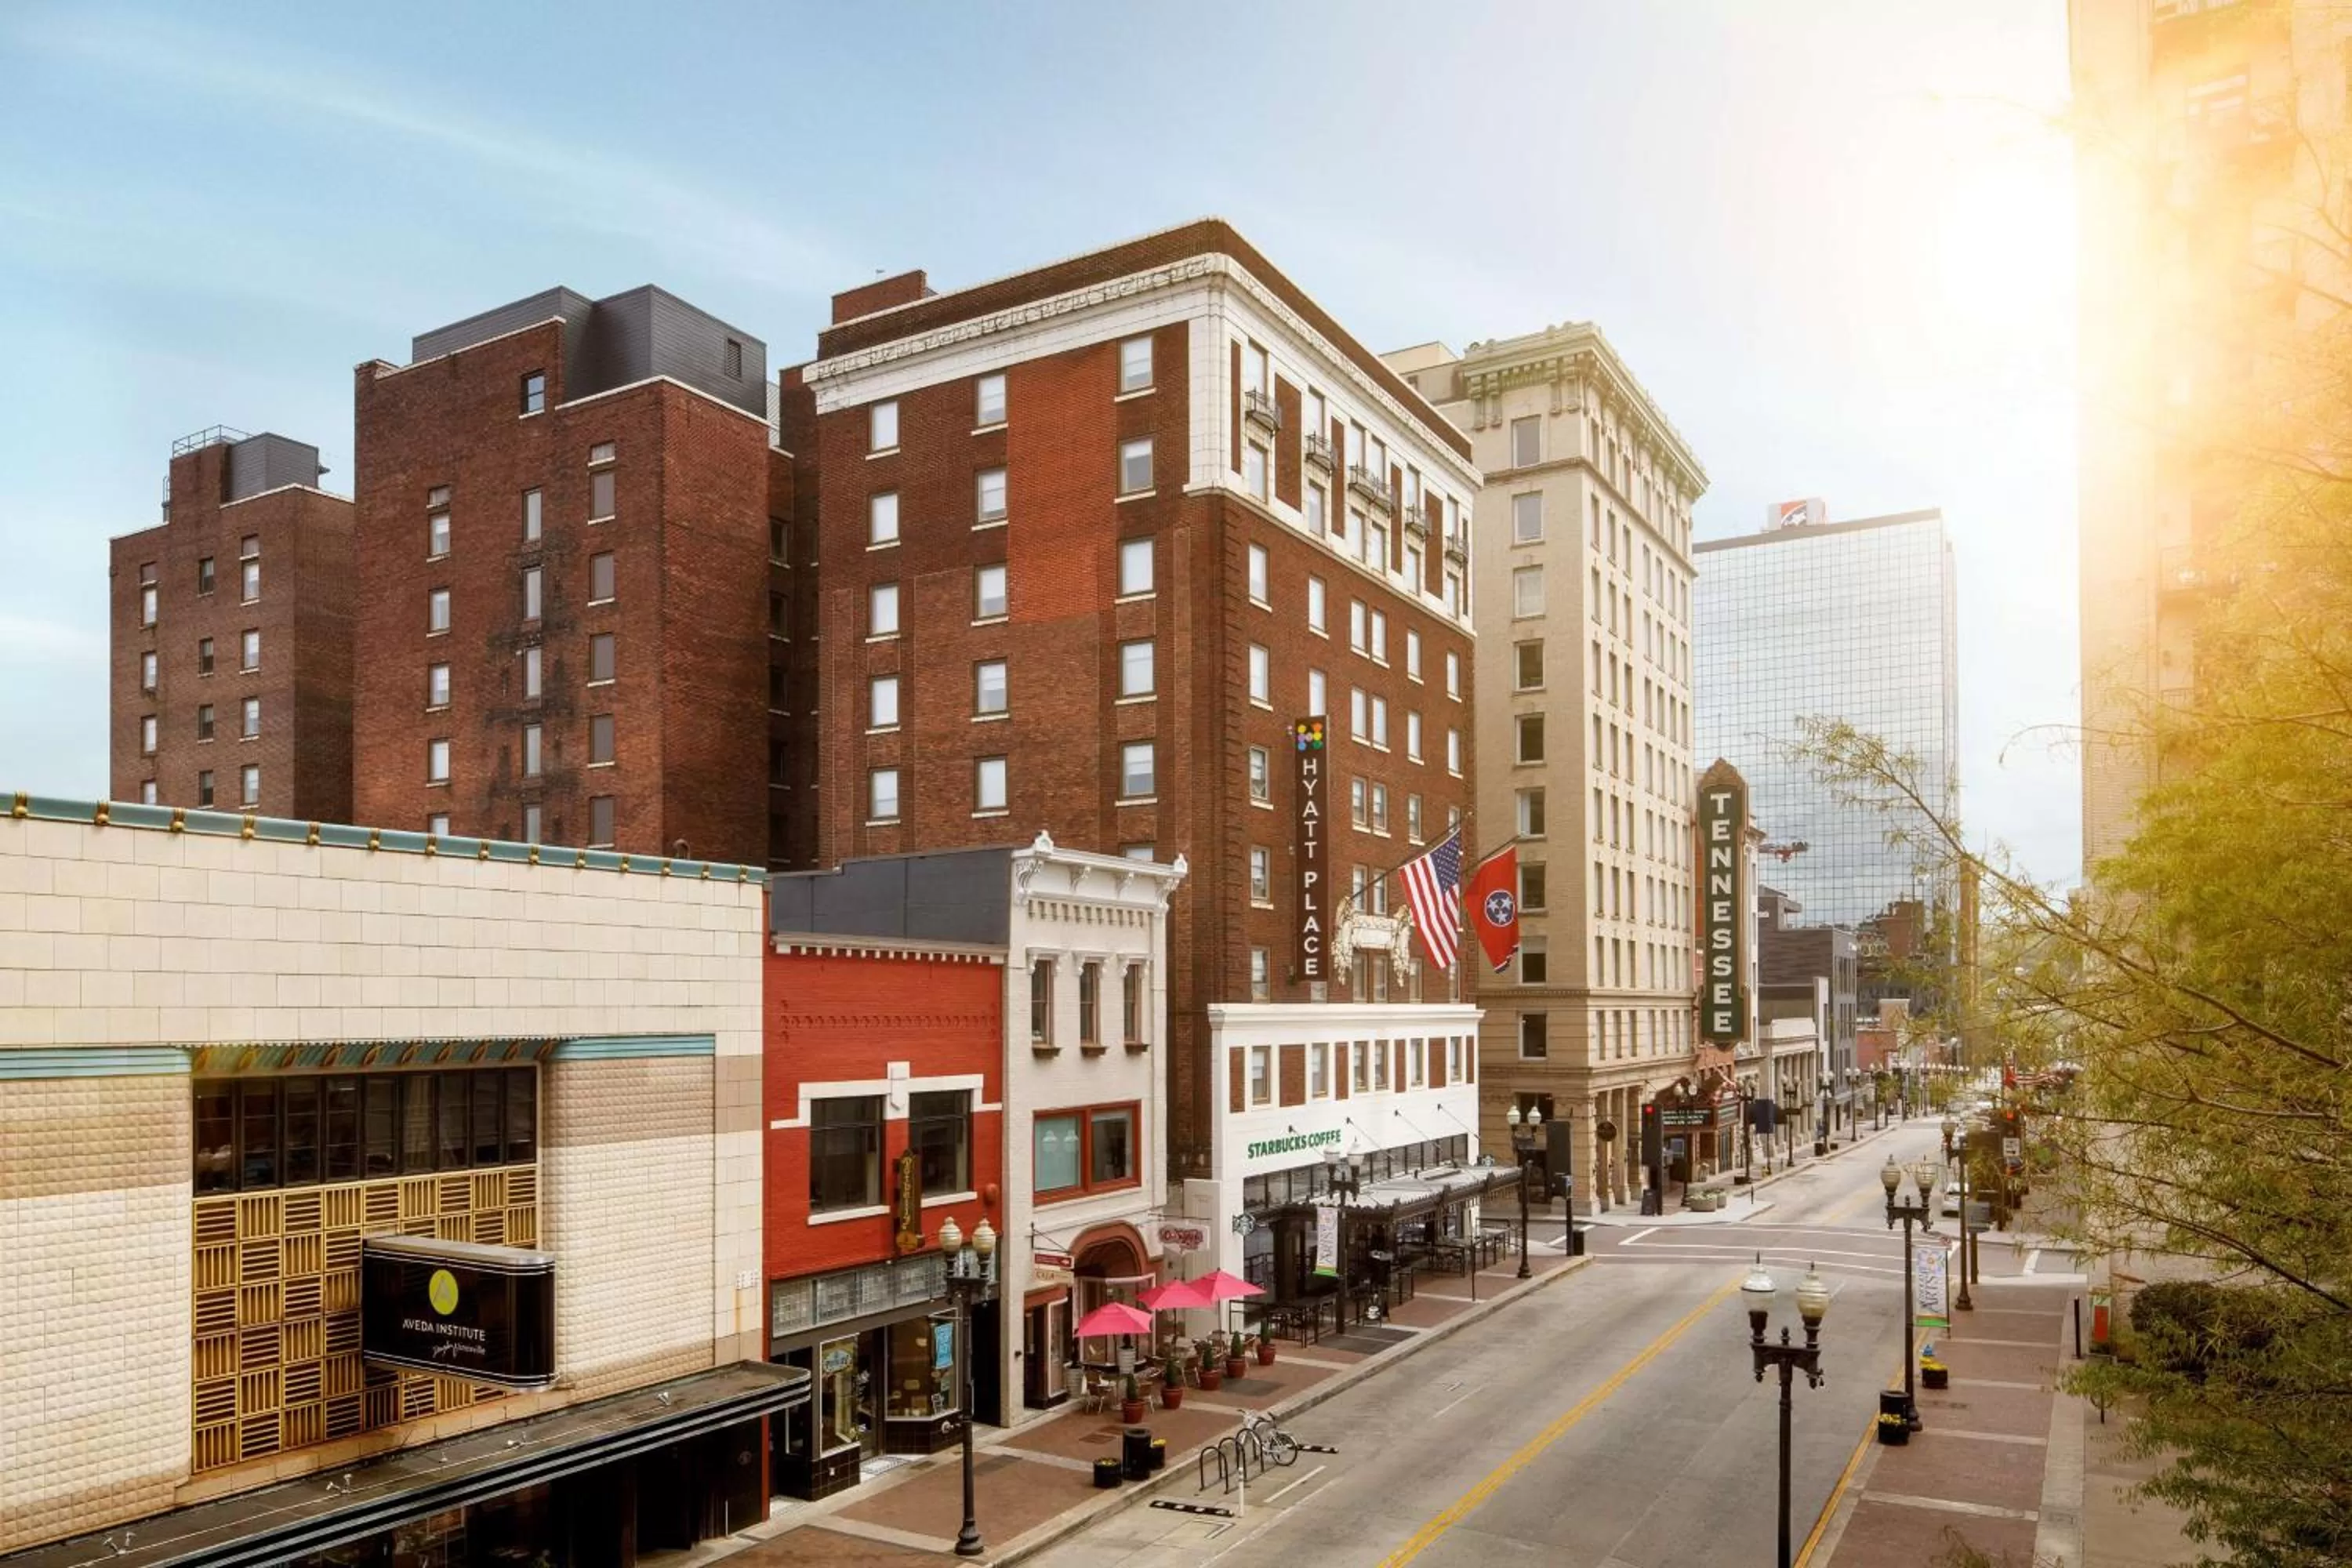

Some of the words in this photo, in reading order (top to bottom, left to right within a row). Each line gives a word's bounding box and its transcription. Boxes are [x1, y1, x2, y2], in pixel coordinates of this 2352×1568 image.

[1302, 758, 1319, 858] HYATT
[1303, 871, 1320, 975] PLACE
[1710, 792, 1732, 1033] TENNESSEE
[1247, 1134, 1307, 1160] STARBUCKS
[402, 1319, 434, 1333] AVEDA
[436, 1323, 486, 1341] INSTITUTE
